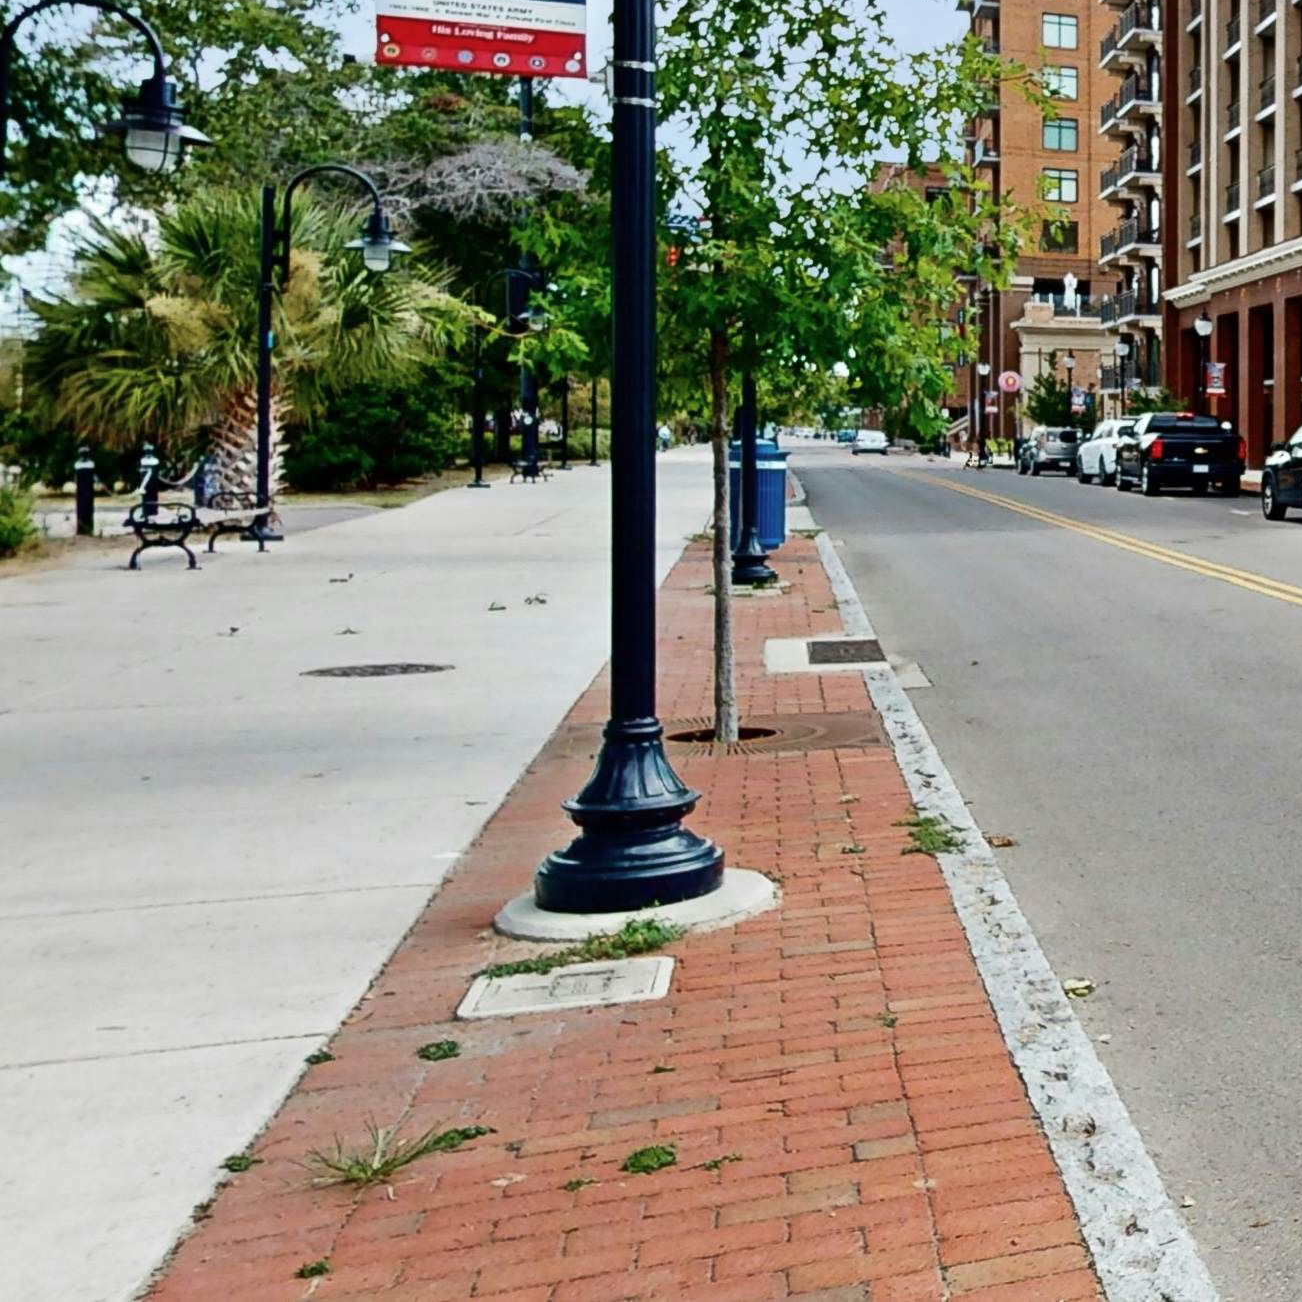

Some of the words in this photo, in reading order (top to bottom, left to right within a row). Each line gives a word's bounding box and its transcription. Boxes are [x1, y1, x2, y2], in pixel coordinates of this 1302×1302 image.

[432, 0, 467, 9] UNITED
[470, 2, 504, 12] STATES
[507, 6, 533, 15] ARMY
[431, 24, 451, 36] His
[454, 25, 494, 40] Loving
[496, 29, 536, 44] Family
